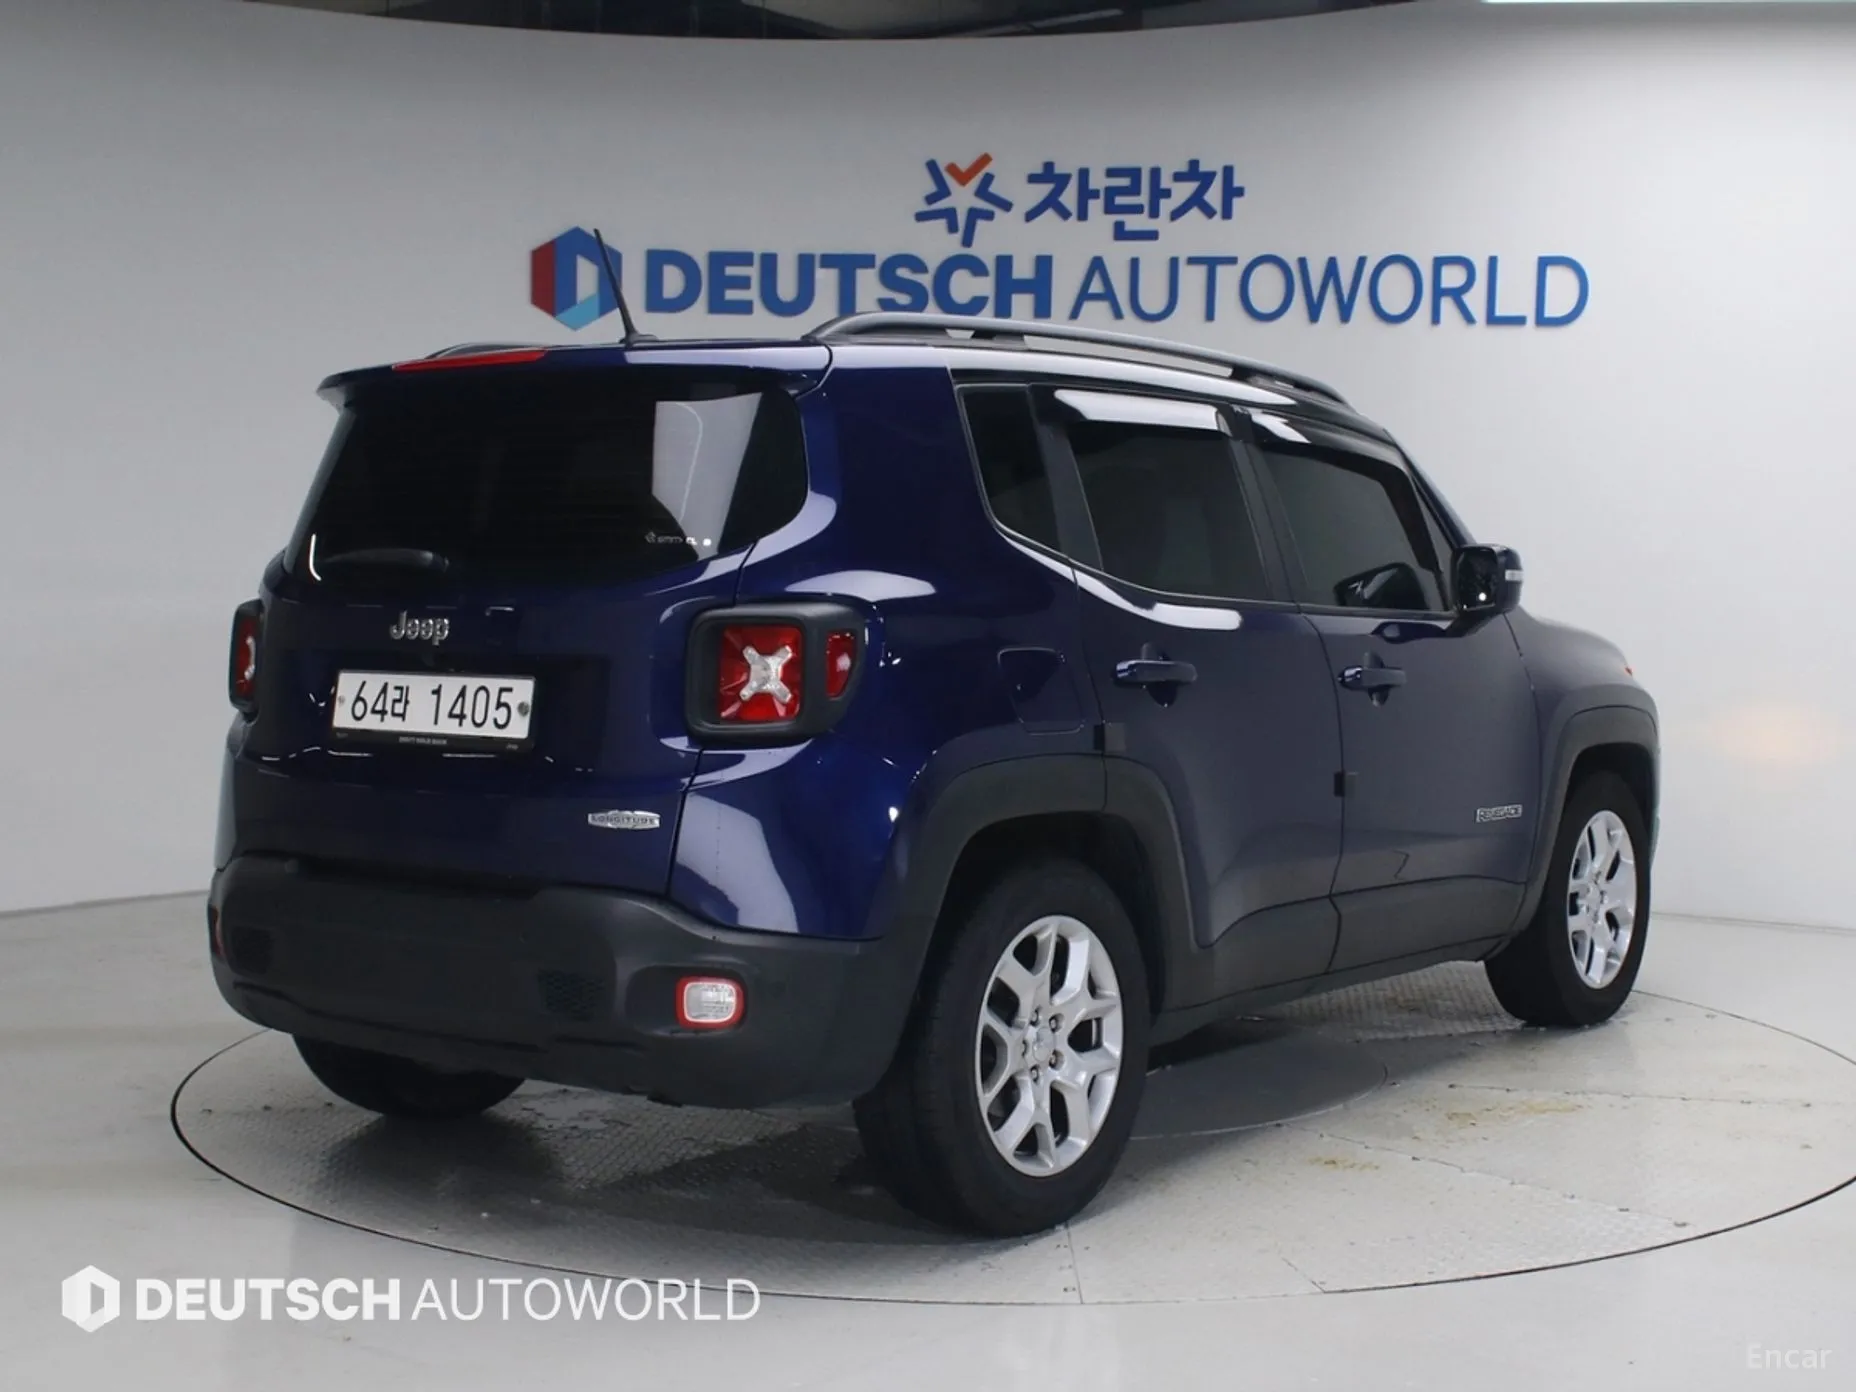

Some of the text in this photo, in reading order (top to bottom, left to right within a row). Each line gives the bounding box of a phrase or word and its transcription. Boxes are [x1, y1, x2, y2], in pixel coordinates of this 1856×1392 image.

[1025, 159, 1245, 241] 차란차
[645, 248, 1590, 327] DEUTSCH AUTOWORLD
[390, 610, 449, 646] Jeep
[351, 680, 514, 730] 64라 1405
